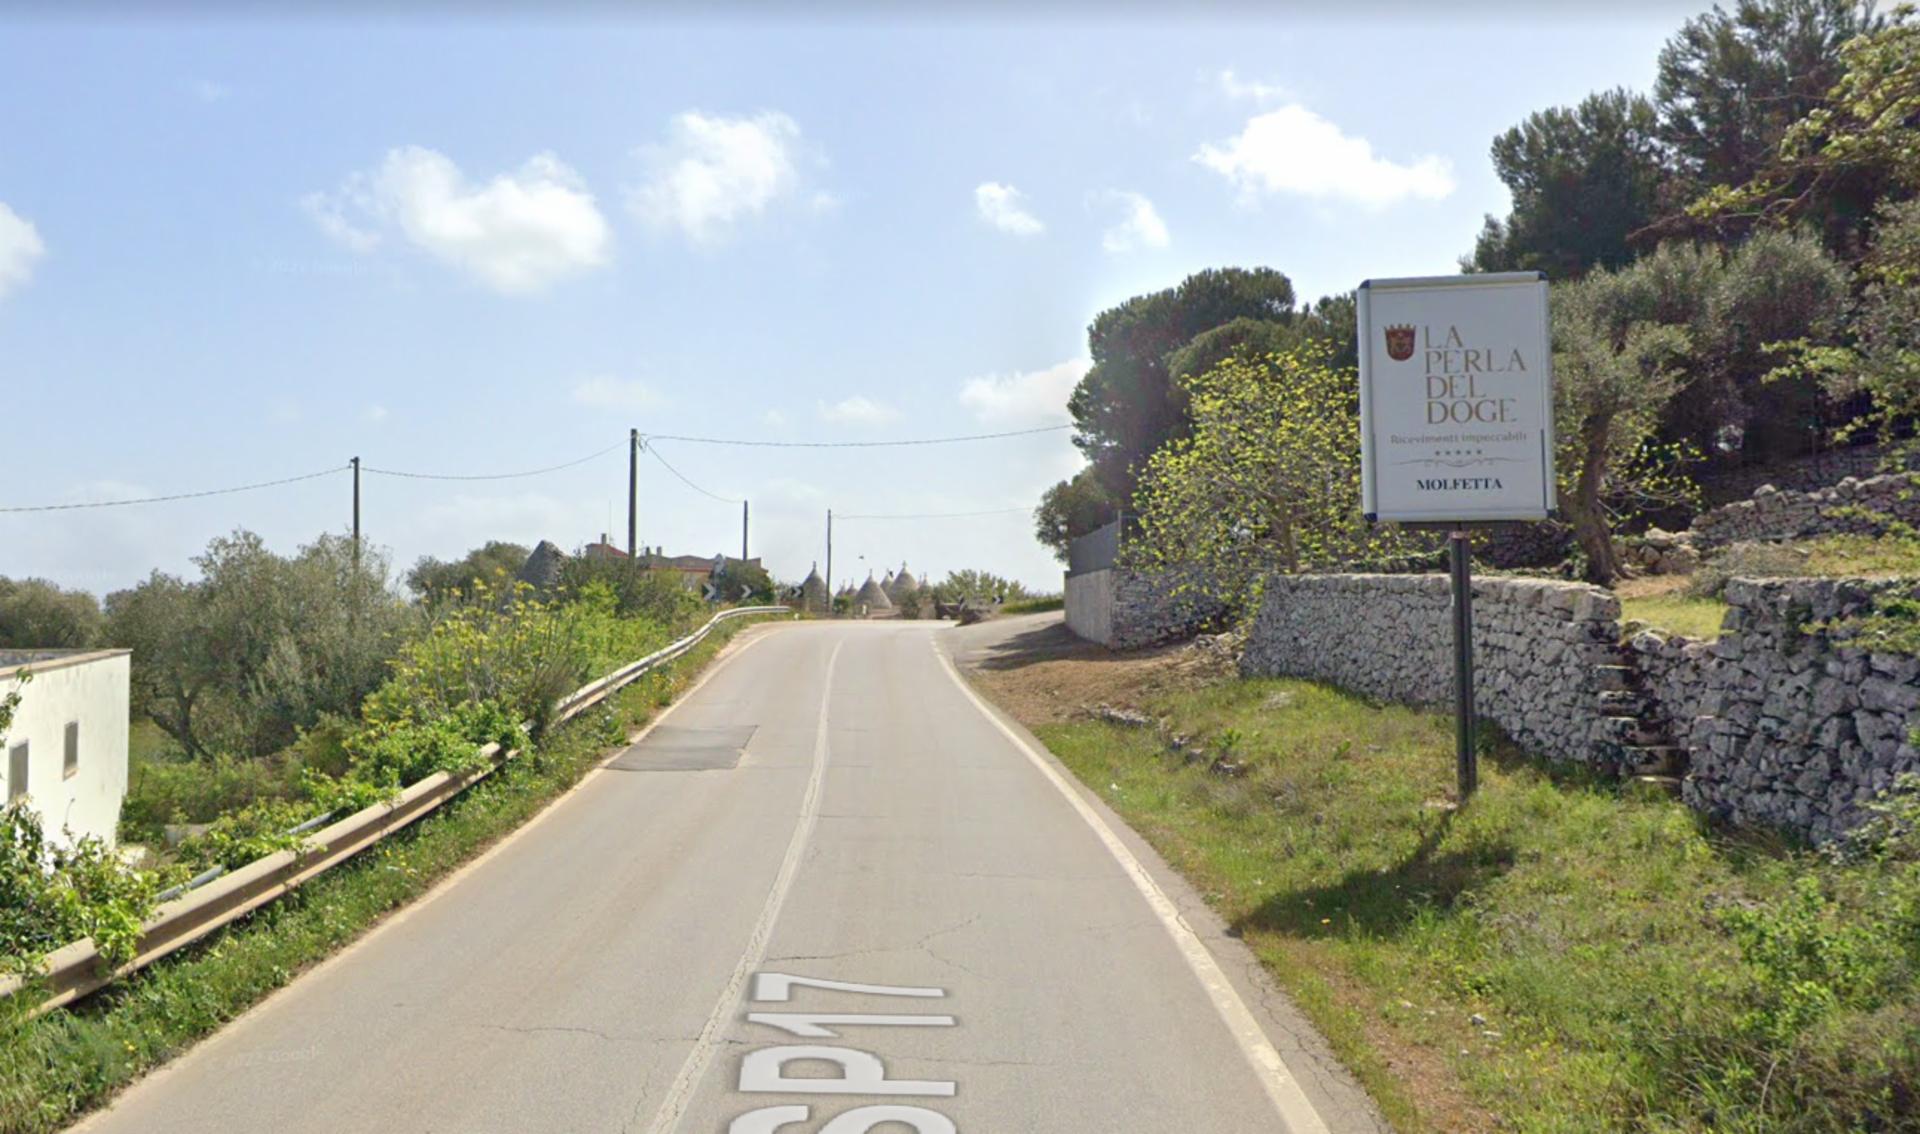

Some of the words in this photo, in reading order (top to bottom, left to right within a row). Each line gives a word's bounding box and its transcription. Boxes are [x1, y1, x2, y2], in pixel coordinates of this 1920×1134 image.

[1424, 325, 1463, 348] LA
[1425, 348, 1526, 374] PERLA
[1426, 375, 1487, 399] DEL
[1427, 399, 1517, 424] DOGE
[1416, 478, 1503, 490] MOLFETTA
